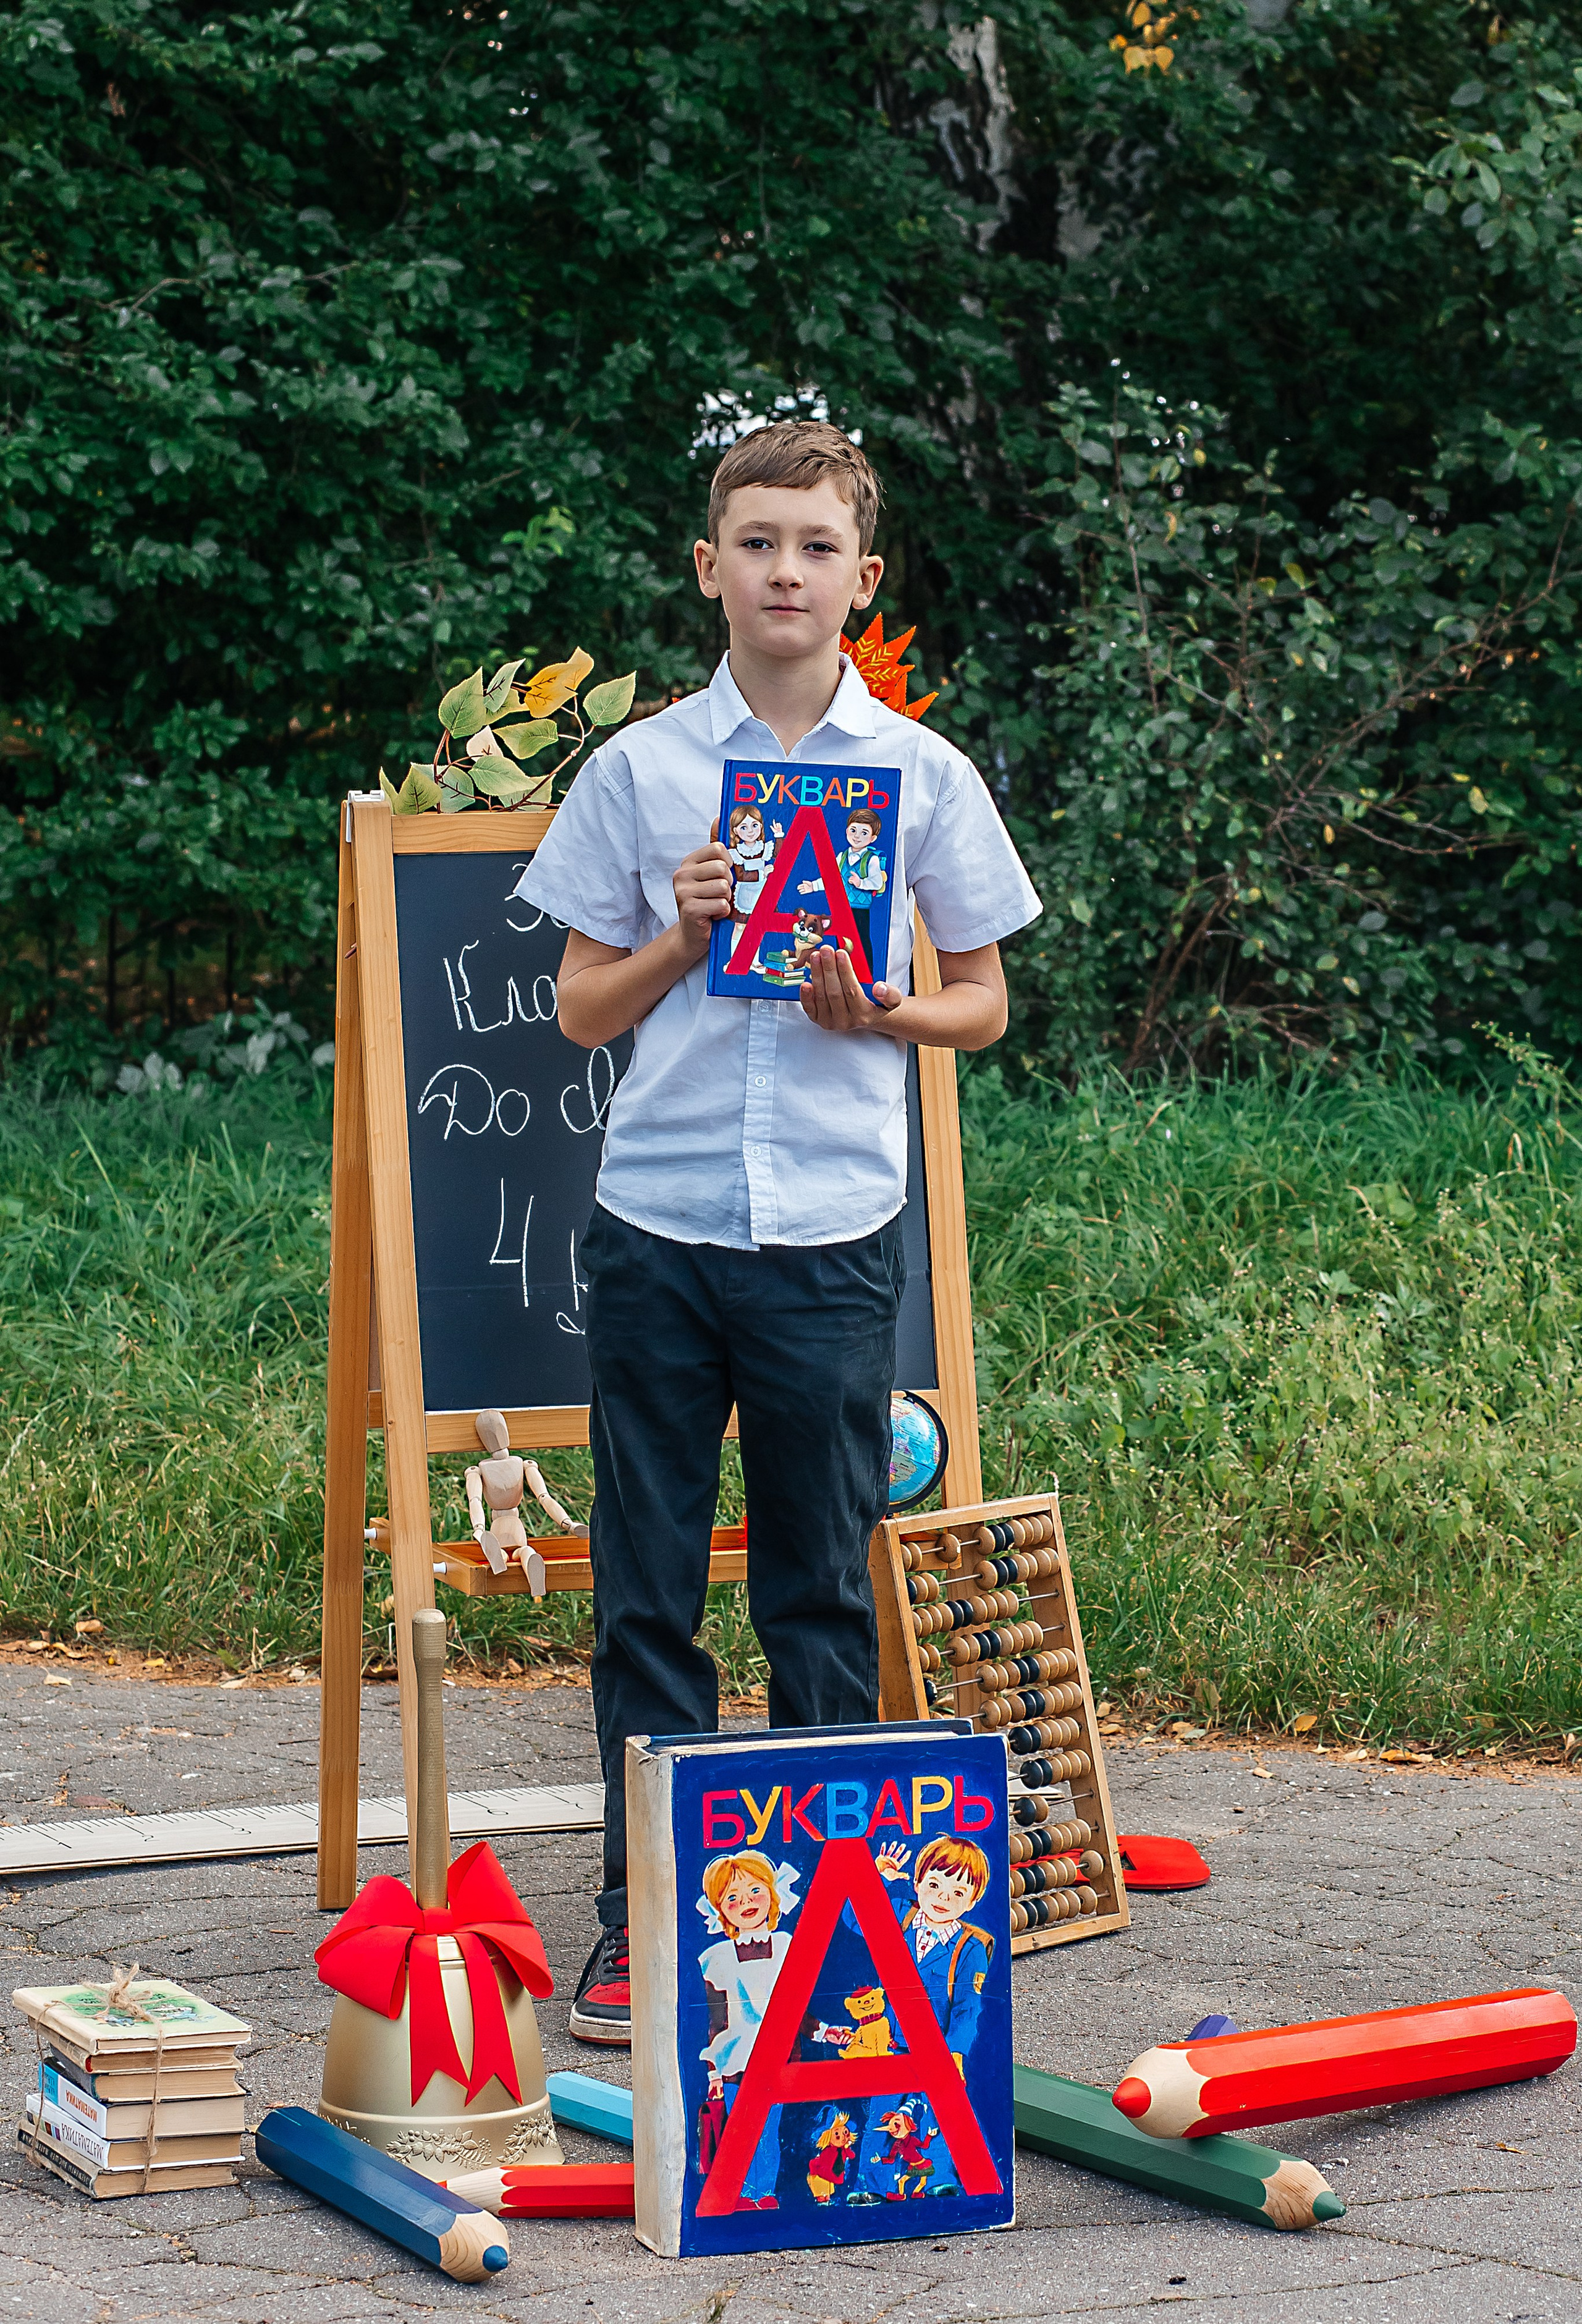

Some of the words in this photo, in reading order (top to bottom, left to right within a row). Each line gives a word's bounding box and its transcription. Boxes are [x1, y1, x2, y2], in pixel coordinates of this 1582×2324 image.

[734, 772, 890, 809] БУКВАРЬ
[724, 806, 874, 984] А
[418, 1063, 530, 1141] До
[489, 1177, 535, 1308] 4
[702, 1775, 995, 1849] БУКВАРЬ
[695, 1838, 1004, 2217] А
[61, 2122, 104, 2162] МАТЕМАТИКА
[66, 2089, 98, 2123] МАТЕМАТИКА
